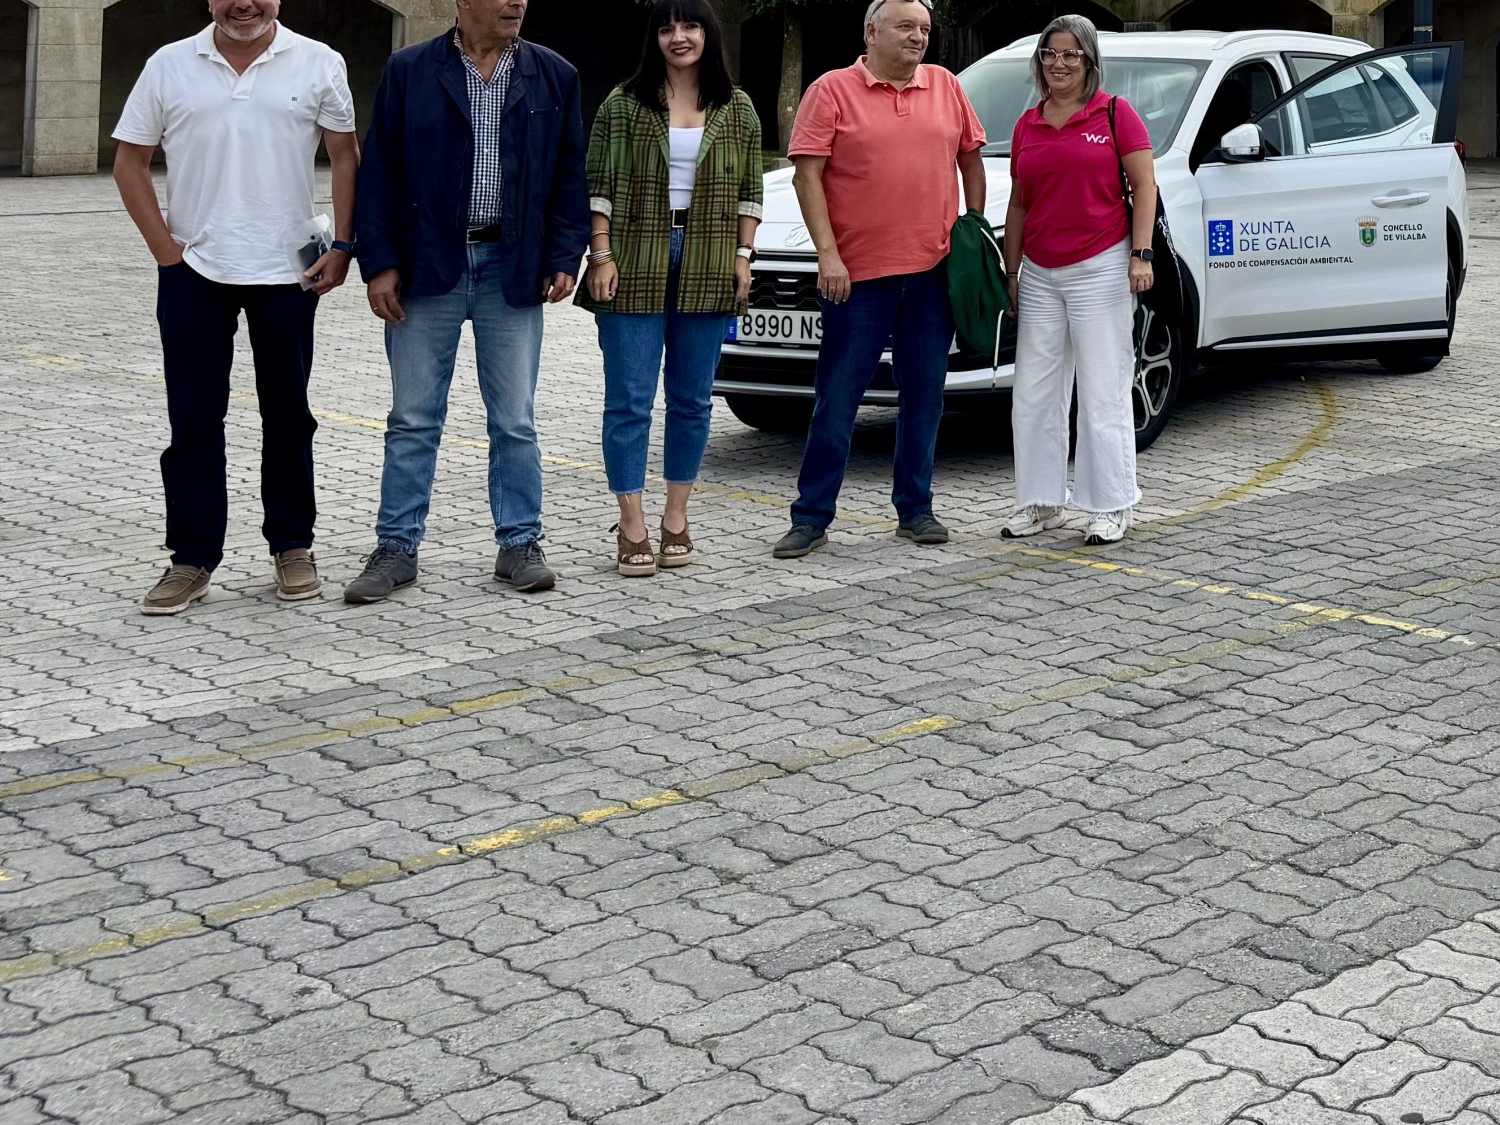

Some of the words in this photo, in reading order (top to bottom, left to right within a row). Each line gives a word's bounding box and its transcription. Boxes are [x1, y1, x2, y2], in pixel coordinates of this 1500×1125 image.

[1239, 220, 1295, 236] XUNTA
[1383, 223, 1423, 232] CONCELLO
[1239, 238, 1260, 252] DE
[1265, 235, 1331, 251] GALICIA
[1383, 234, 1394, 242] DE
[1395, 232, 1427, 241] VILALBA
[1208, 261, 1236, 269] FONDO
[1237, 260, 1248, 268] DE
[1248, 257, 1308, 268] COMPENSACIÓN
[1309, 256, 1354, 265] AMBIENTAL
[742, 314, 793, 338] 8990
